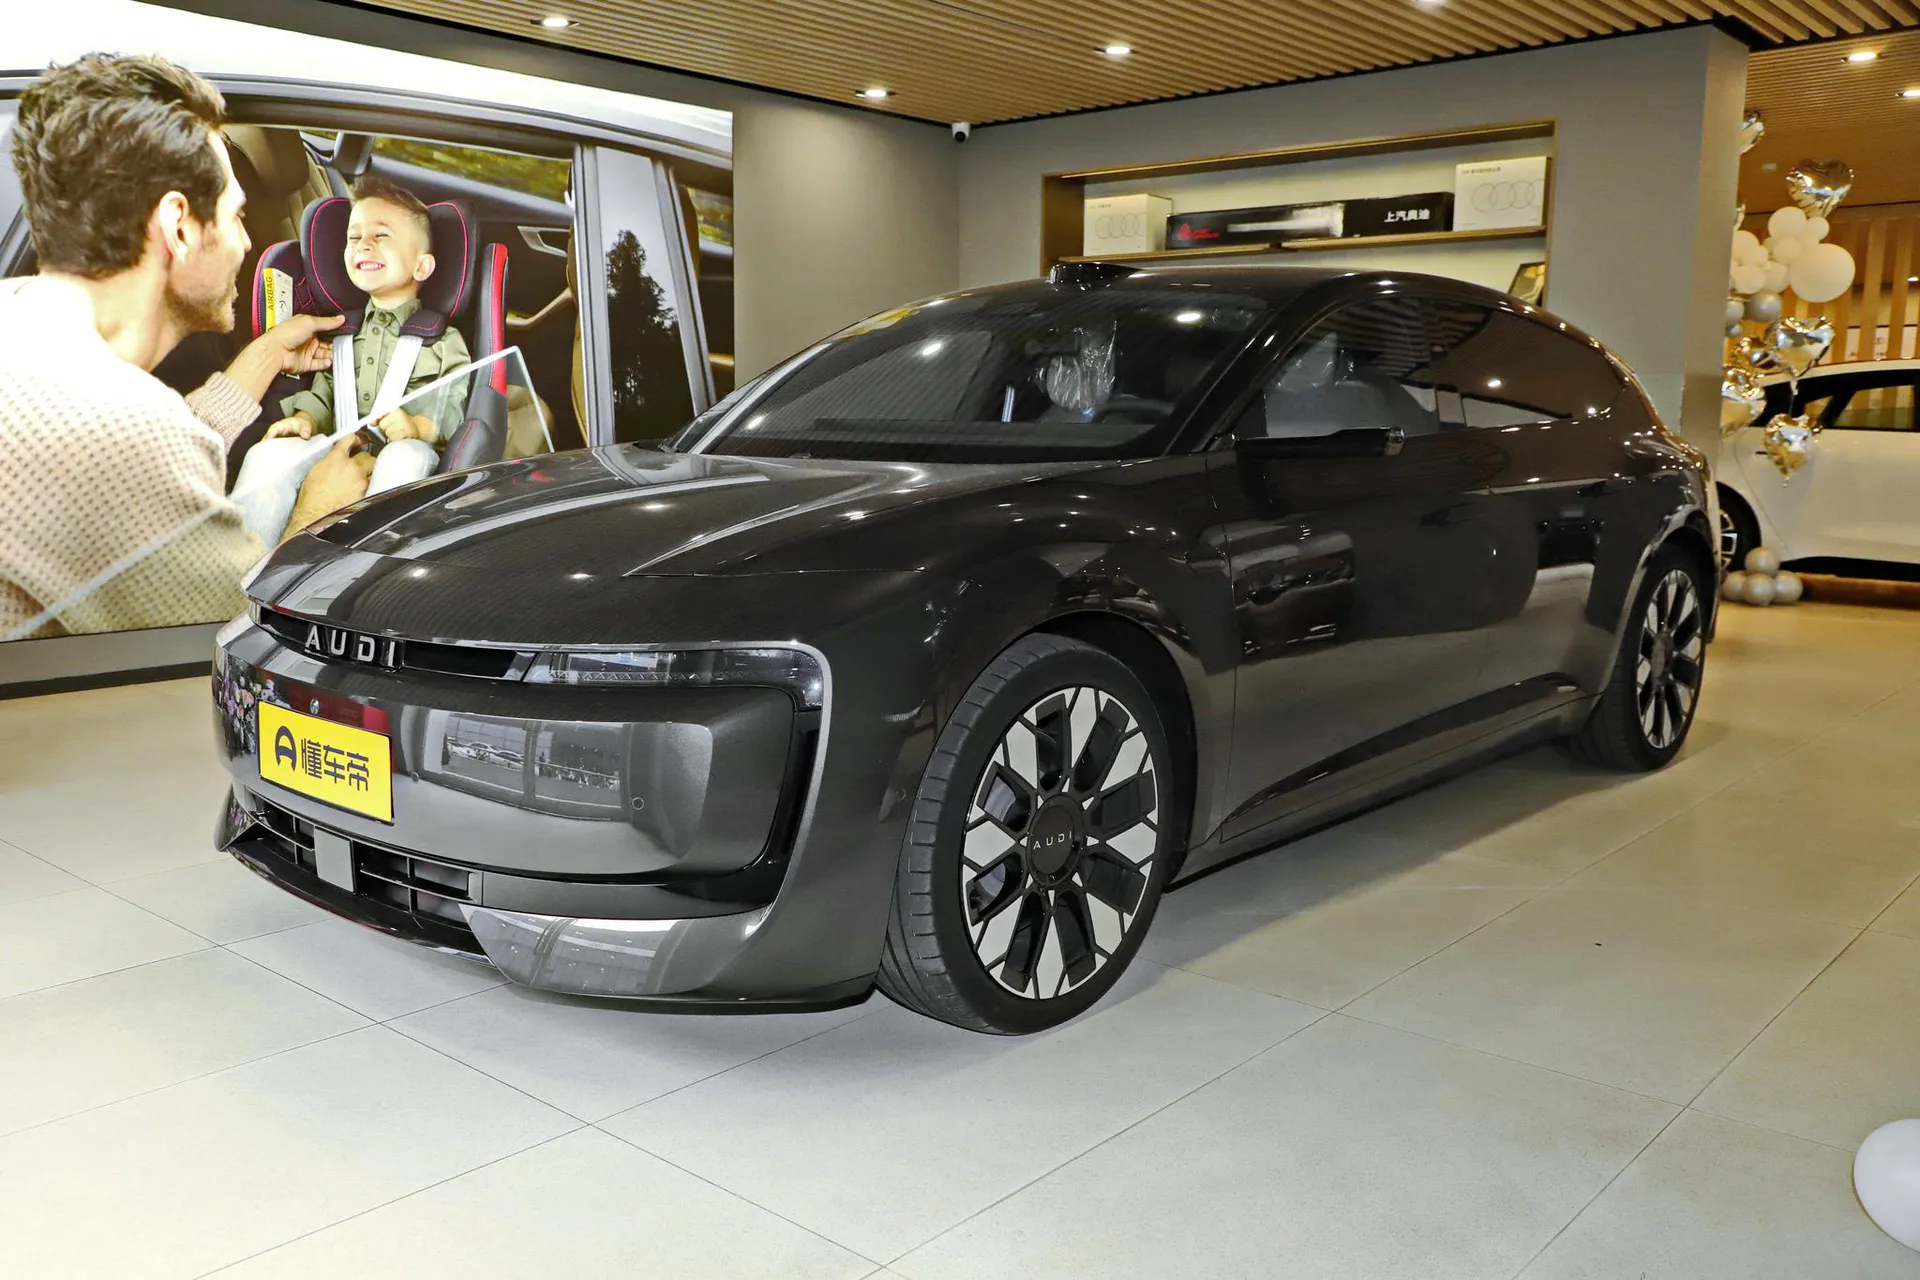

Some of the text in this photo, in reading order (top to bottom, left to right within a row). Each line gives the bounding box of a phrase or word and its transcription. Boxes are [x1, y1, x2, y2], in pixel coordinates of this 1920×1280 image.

[265, 276, 275, 311] AIRBAG
[305, 625, 395, 667] AUDI
[300, 738, 369, 791] 懂车帝
[1033, 830, 1072, 850] AUDI
